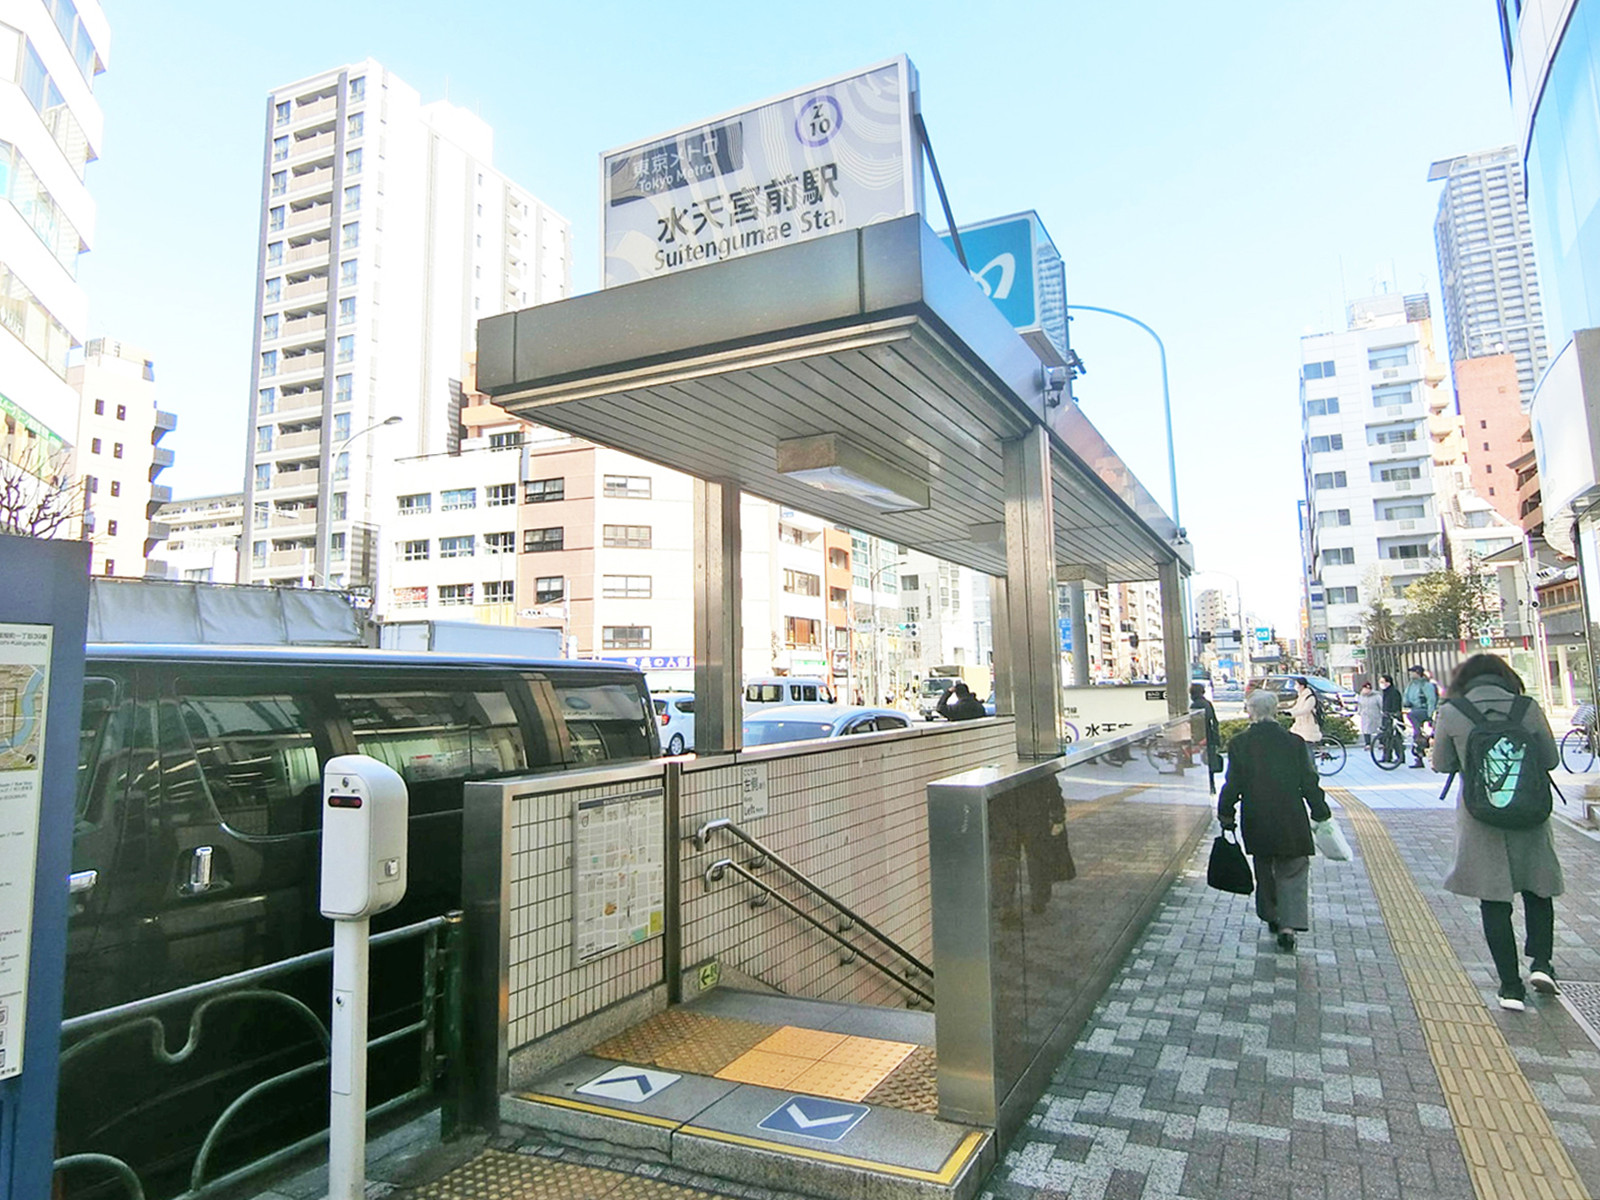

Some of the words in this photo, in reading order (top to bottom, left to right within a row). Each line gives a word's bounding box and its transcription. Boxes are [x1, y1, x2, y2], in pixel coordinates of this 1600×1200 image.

[809, 118, 831, 137] 10
[812, 103, 824, 120] Z
[632, 137, 719, 179] 東京メトロ
[639, 175, 673, 193] Tokyo
[676, 163, 713, 182] Metro
[657, 162, 840, 243] 水天宮前駅
[654, 219, 792, 271] Suitengumae
[800, 208, 844, 234] Sta.
